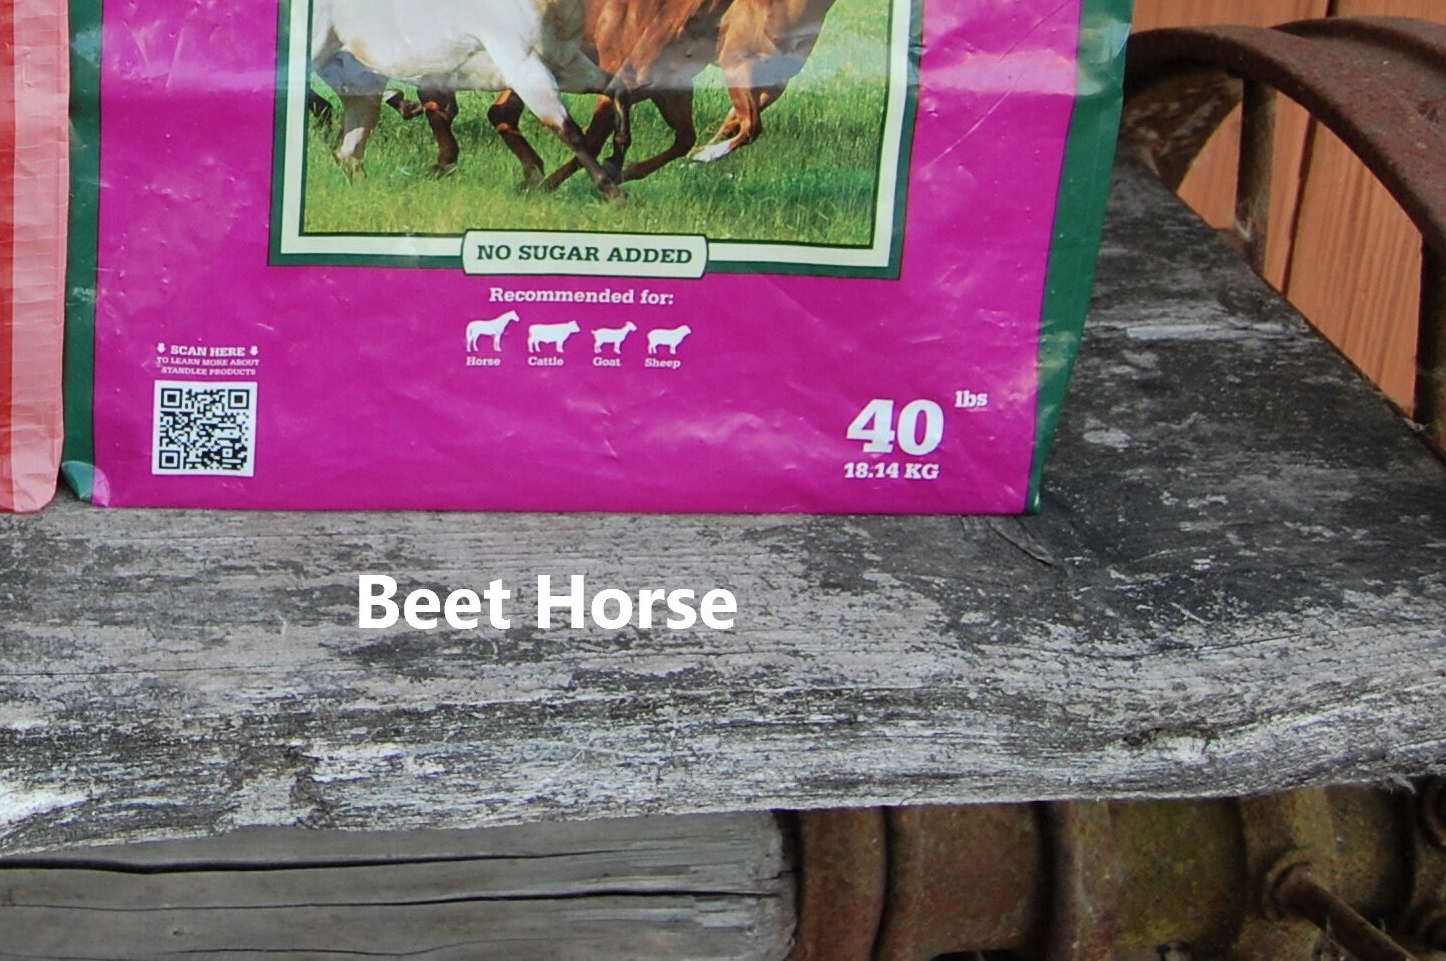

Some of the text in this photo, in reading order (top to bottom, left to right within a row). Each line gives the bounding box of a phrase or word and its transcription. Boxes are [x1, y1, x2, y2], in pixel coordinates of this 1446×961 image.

[476, 245, 692, 264] NO SUGAR ADDED
[489, 287, 674, 305] Recommended for:
[171, 345, 246, 356] SCAN HERE
[156, 356, 168, 364] TO
[171, 357, 200, 365] LEARN
[230, 358, 260, 366] ABOUT
[466, 356, 501, 366] Horse
[528, 356, 564, 366] Cattle
[593, 357, 621, 367] Goat
[645, 358, 681, 369] Sheep
[161, 366, 256, 376] STANDLEE PRODUCTS
[846, 390, 988, 456] 40 lbs
[844, 462, 940, 479] 18.14 KG
